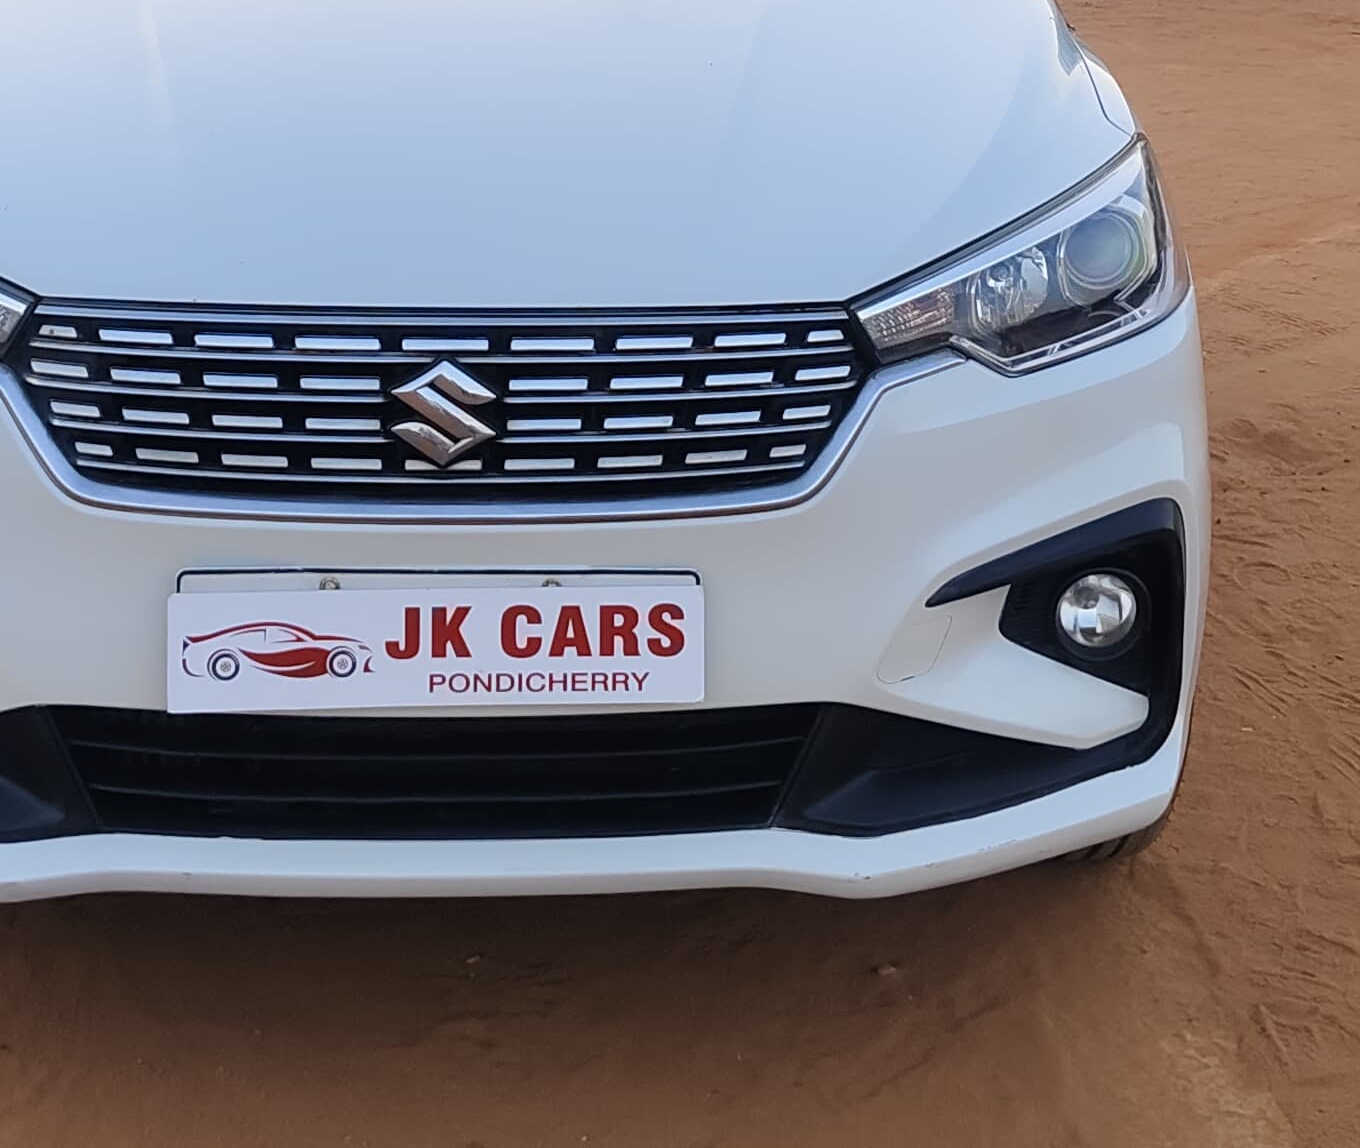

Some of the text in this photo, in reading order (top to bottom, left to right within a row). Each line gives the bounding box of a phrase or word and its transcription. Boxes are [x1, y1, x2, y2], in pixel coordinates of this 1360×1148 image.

[385, 603, 686, 660] JK CARS
[428, 671, 650, 694] PONDICHERRY
